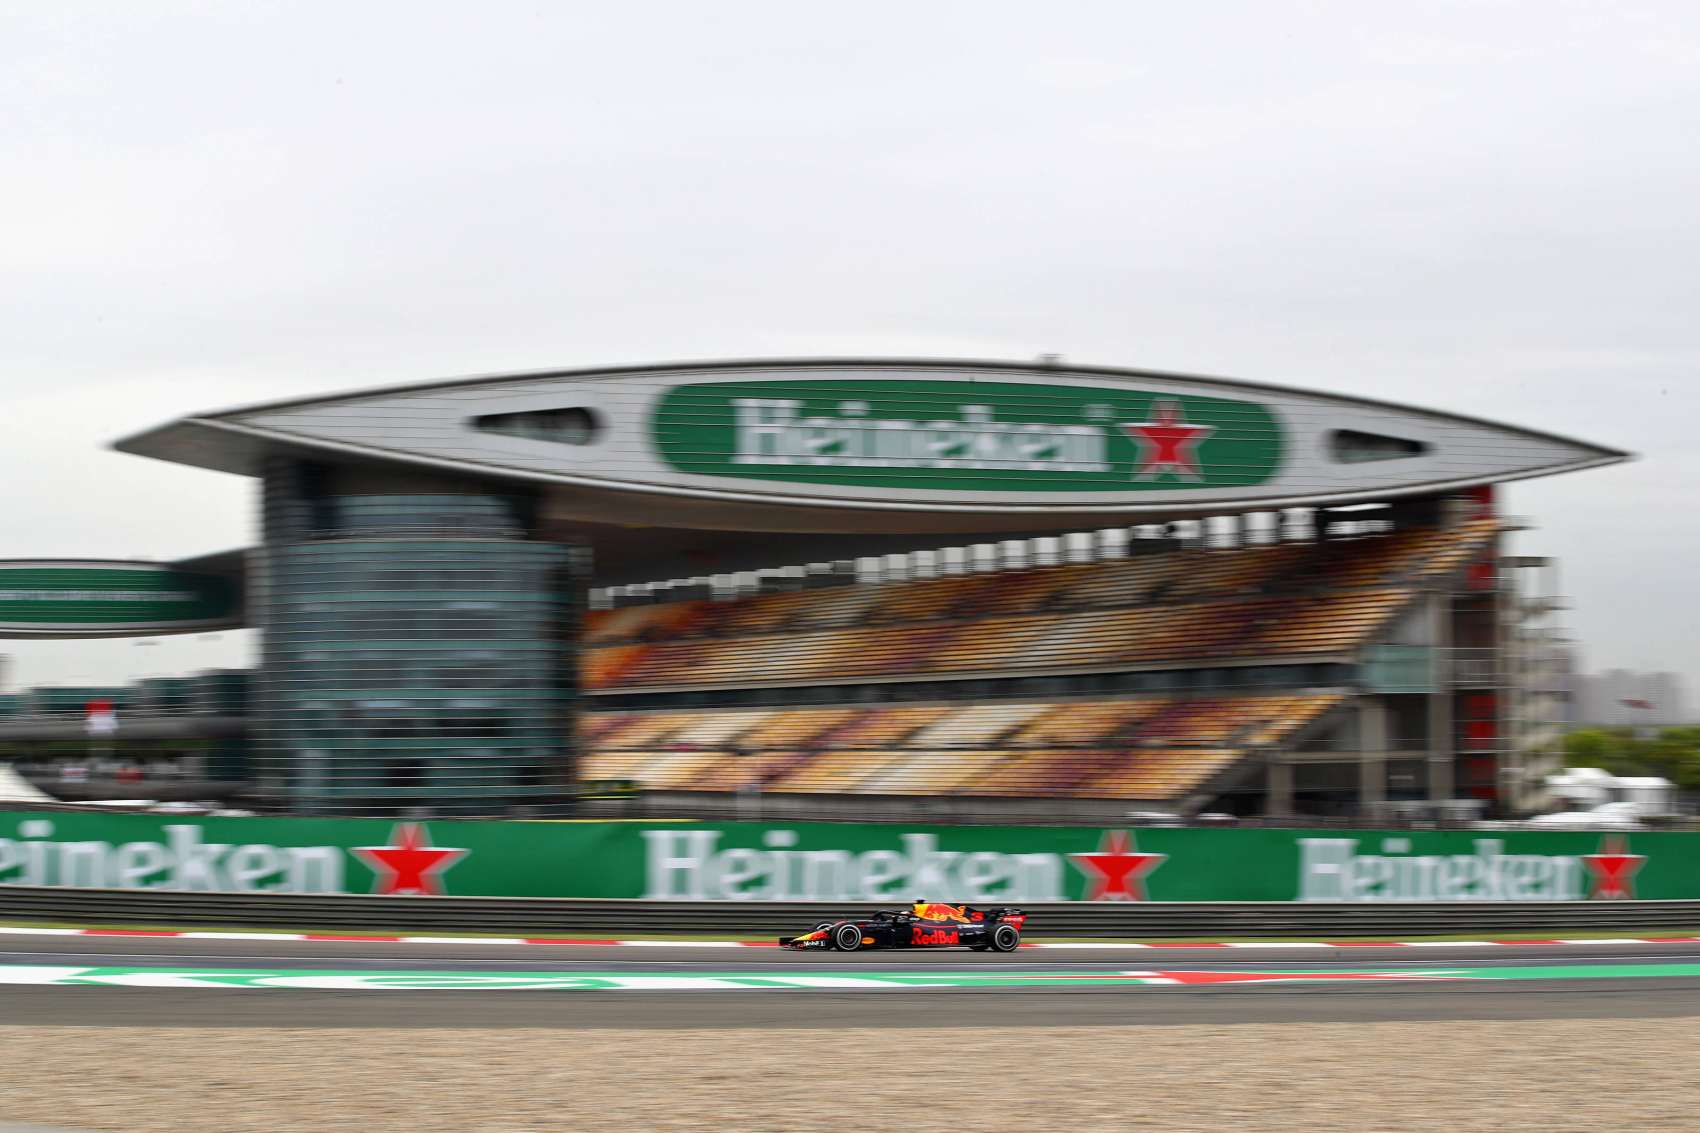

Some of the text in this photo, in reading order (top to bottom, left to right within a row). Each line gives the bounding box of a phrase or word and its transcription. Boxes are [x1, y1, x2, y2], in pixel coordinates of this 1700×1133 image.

[731, 398, 1114, 472] Heineken
[642, 830, 1068, 902] Heineken
[1297, 838, 1587, 902] Heineken
